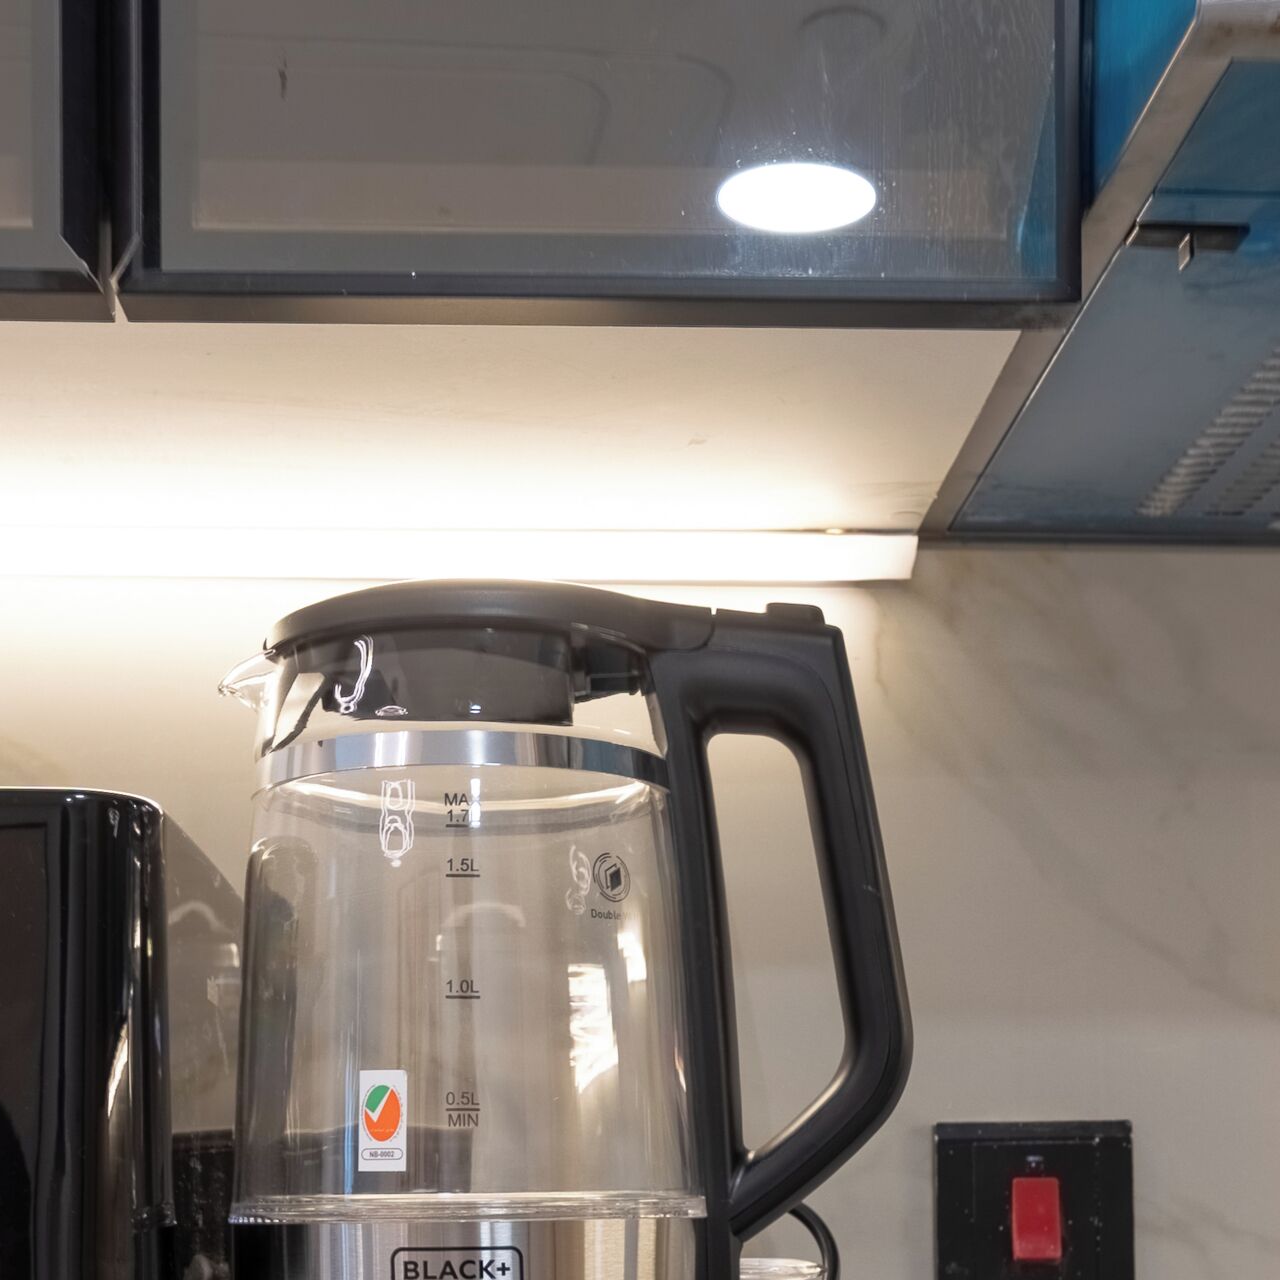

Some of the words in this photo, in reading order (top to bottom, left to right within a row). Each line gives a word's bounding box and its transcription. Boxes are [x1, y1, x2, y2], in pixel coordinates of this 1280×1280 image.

[444, 793, 480, 806] MA
[447, 858, 479, 872] 1.5L
[446, 979, 479, 993] 1.0L
[446, 1091, 480, 1106] 0.5L
[448, 1113, 479, 1127] MIN
[403, 1259, 511, 1280] BLACK+
